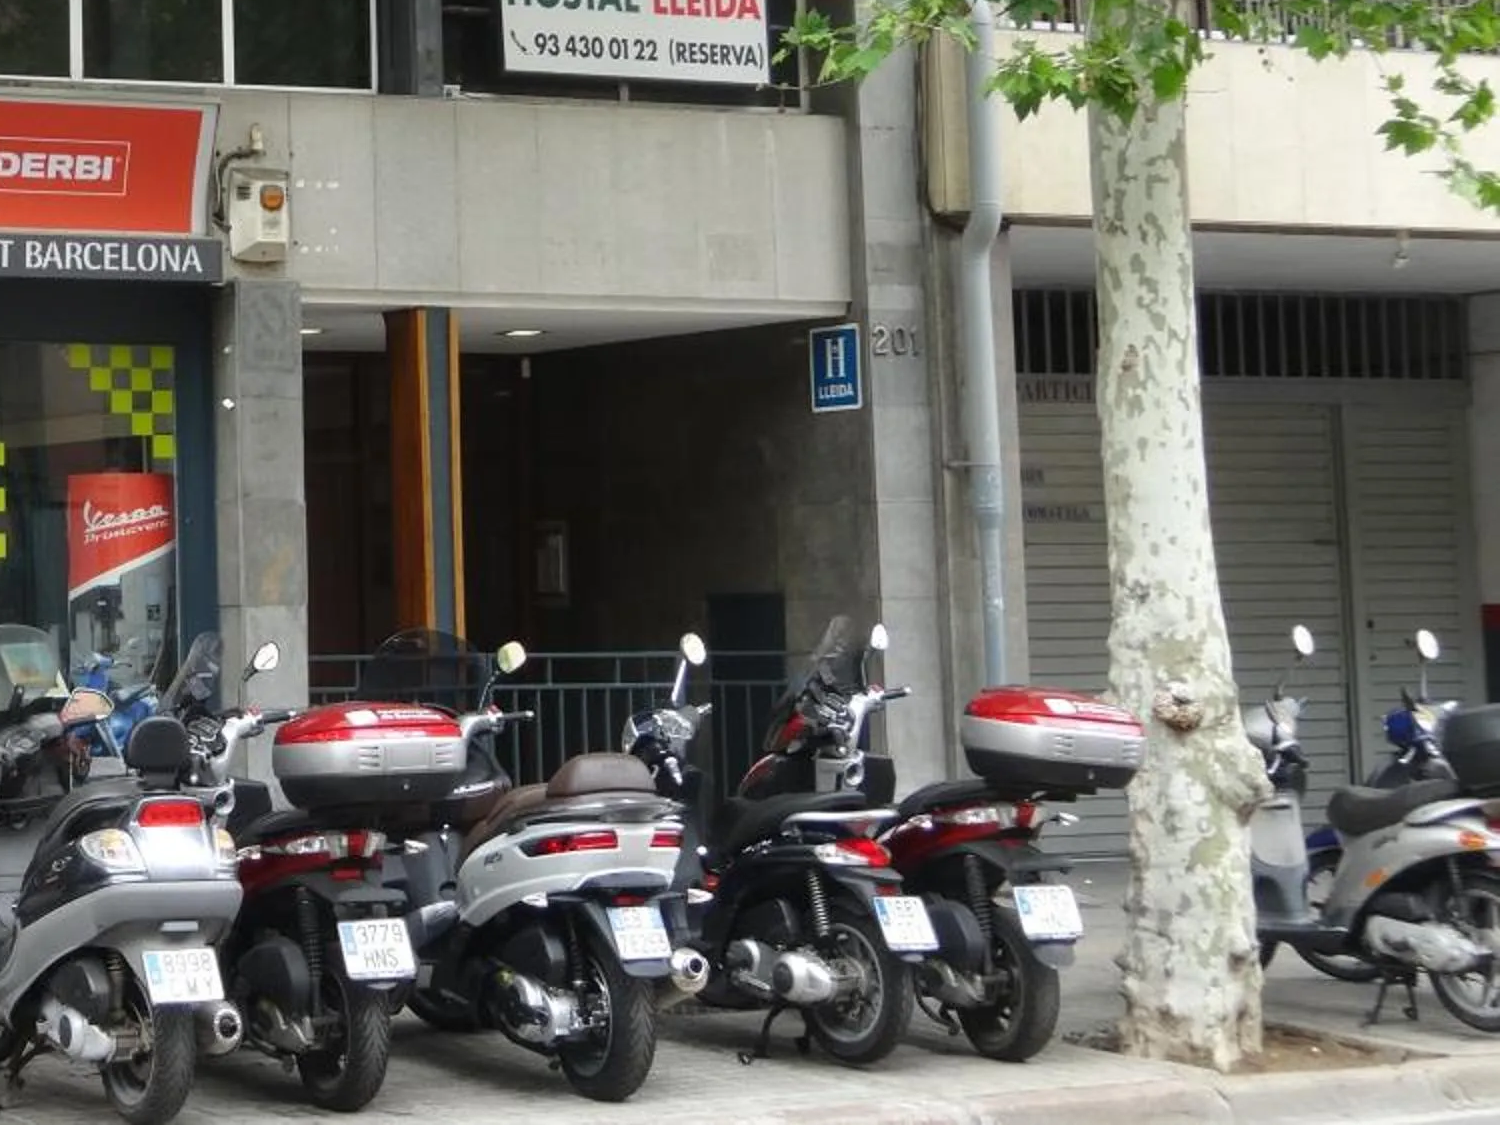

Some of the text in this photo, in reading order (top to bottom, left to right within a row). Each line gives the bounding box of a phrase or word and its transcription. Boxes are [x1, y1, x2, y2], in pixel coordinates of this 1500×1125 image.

[534, 33, 560, 57] 93
[565, 35, 603, 59] 430
[669, 38, 764, 69] (RESERVA)
[25, 239, 204, 273] BARCELONA
[818, 383, 854, 399] LLEIDA
[83, 499, 169, 533] Vespa
[356, 922, 403, 945] 3779
